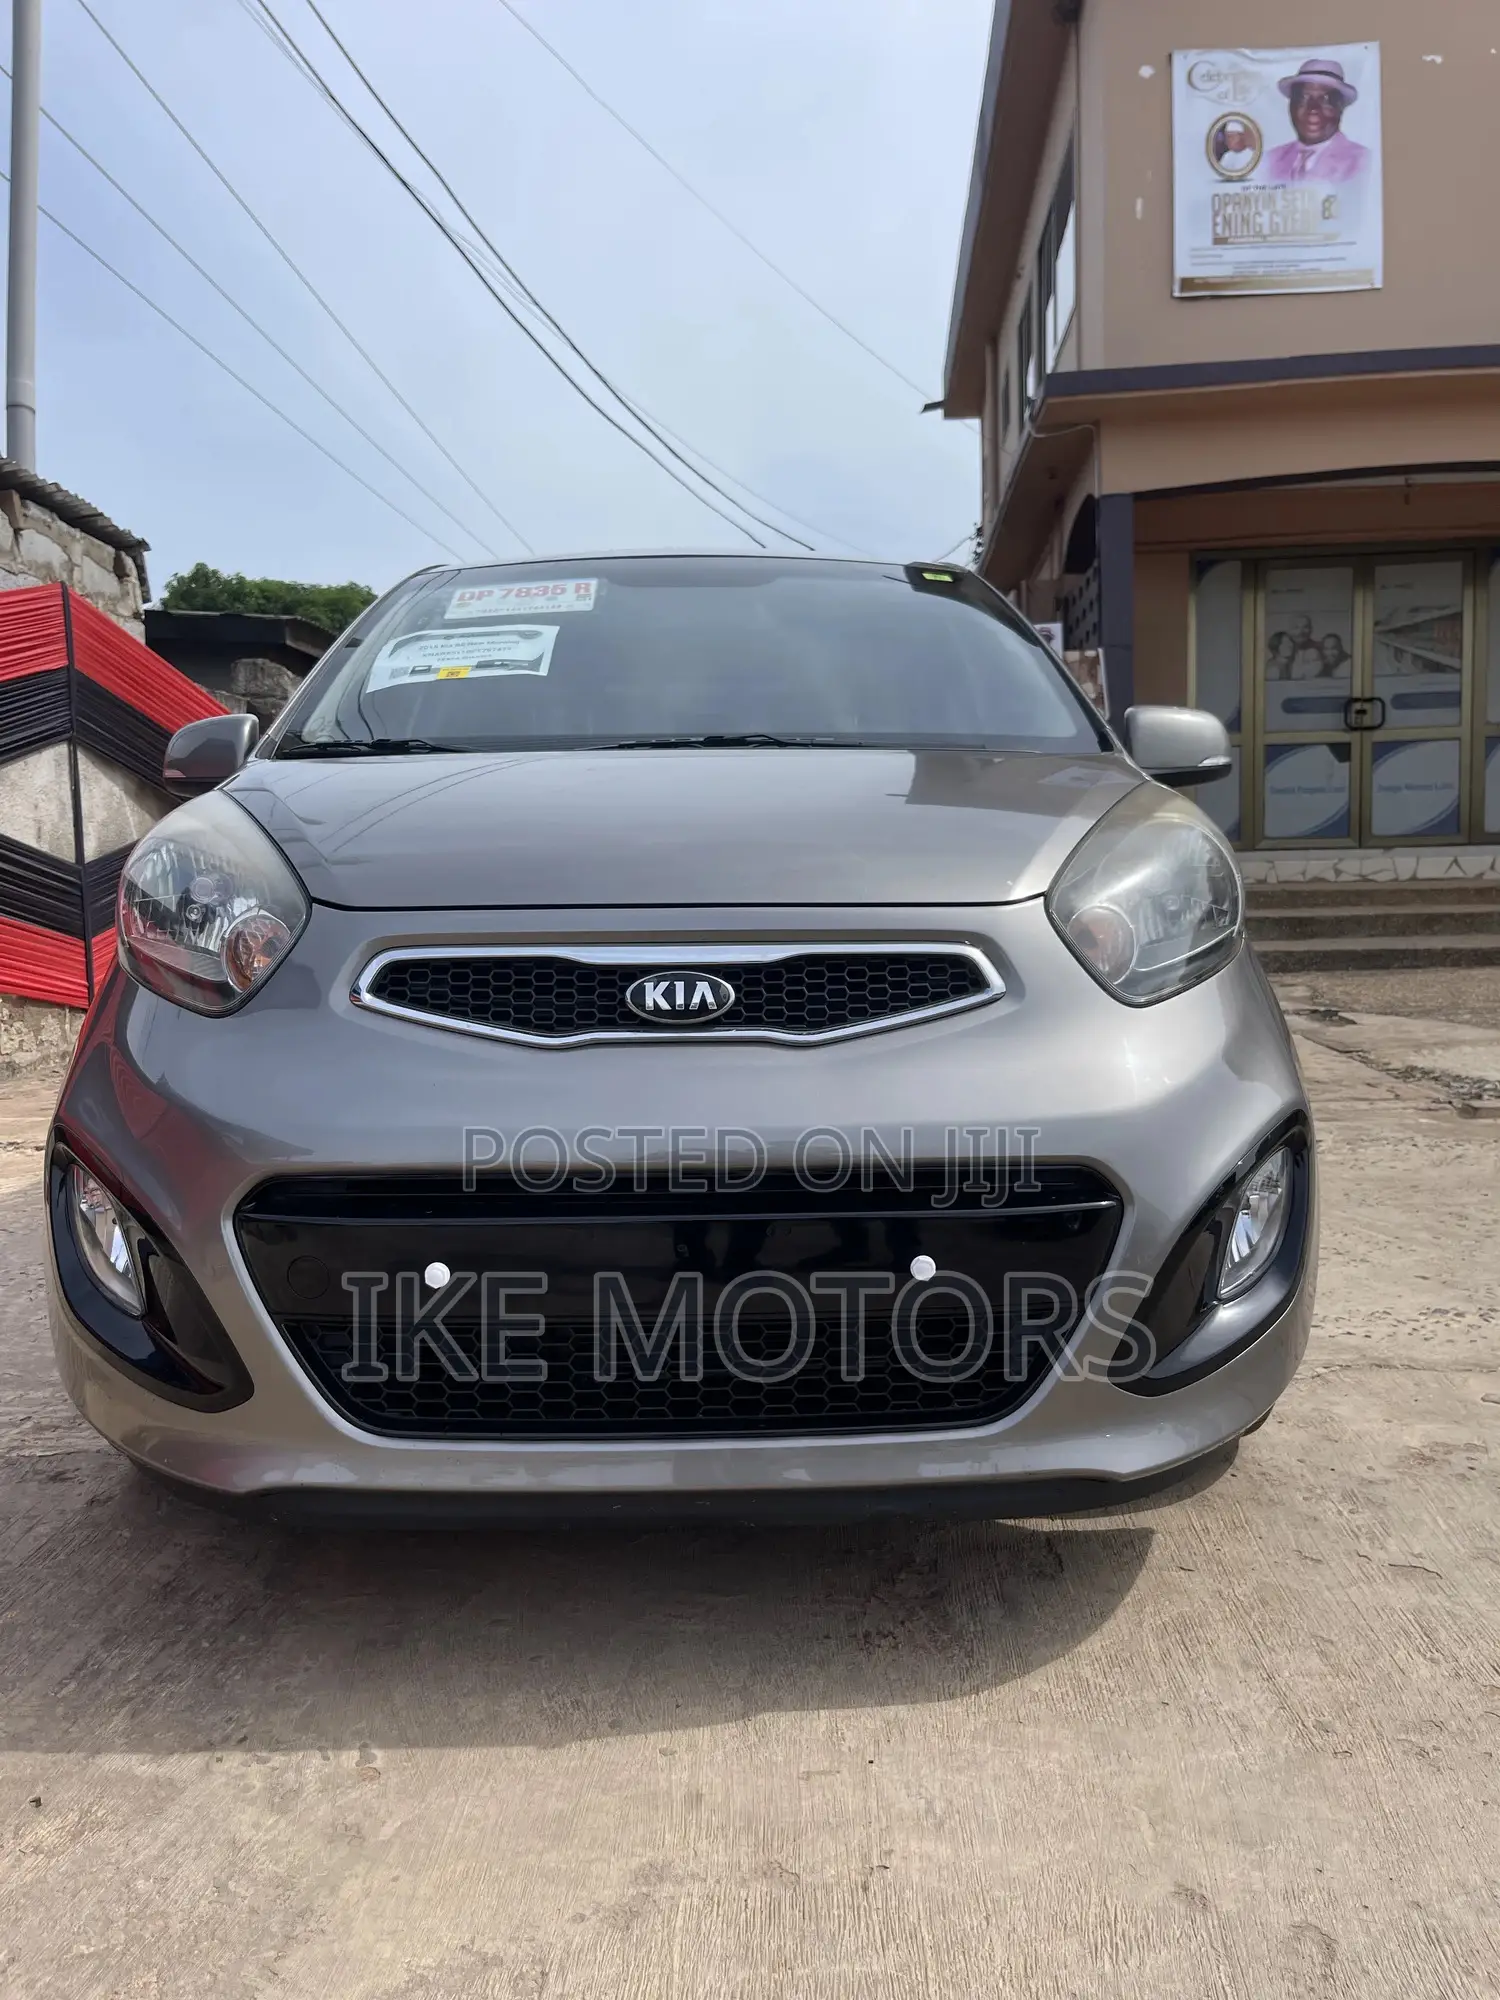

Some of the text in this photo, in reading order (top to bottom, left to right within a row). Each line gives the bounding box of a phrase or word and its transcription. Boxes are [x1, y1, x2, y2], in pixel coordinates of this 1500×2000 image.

[457, 589, 494, 602] DP
[501, 584, 566, 600] 7835
[573, 582, 592, 595] R
[643, 980, 718, 1011] KIA
